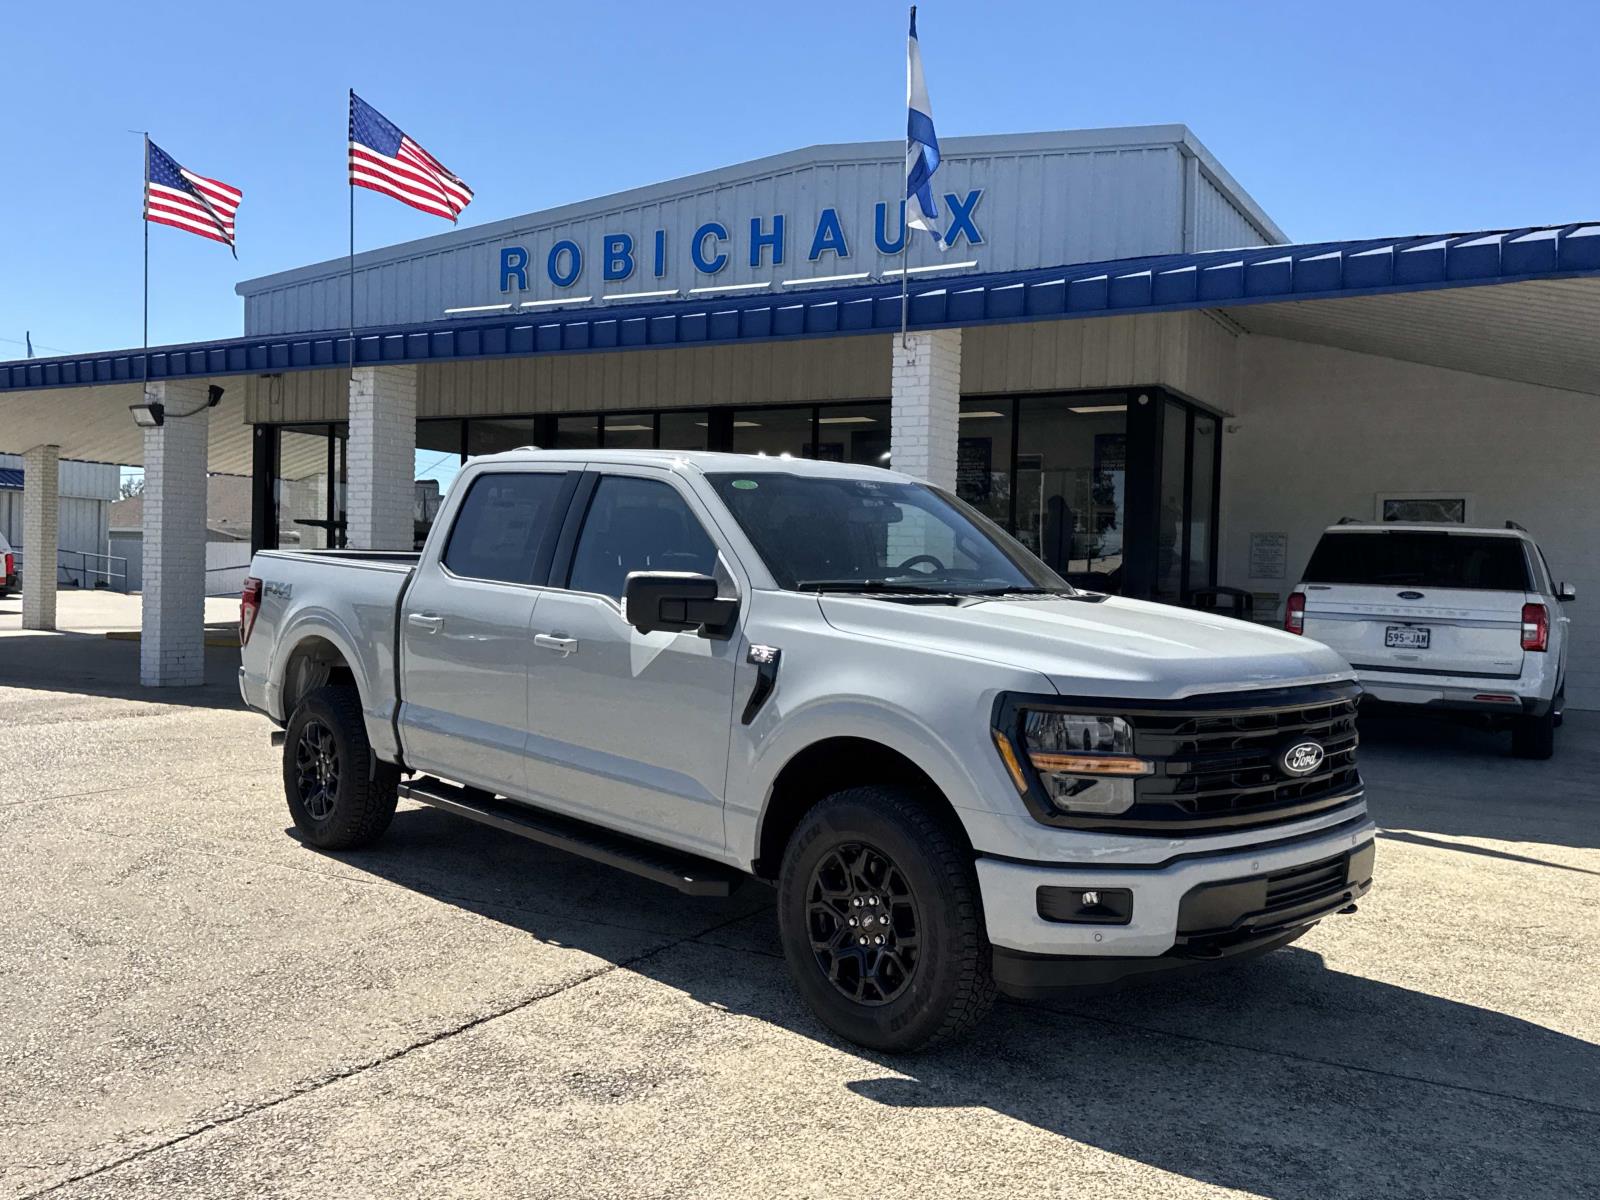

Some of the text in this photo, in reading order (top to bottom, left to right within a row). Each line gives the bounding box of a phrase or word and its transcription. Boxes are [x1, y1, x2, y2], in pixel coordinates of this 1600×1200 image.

[500, 189, 985, 292] ROBICHAUX
[264, 580, 293, 598] FX4
[1292, 746, 1318, 768] Ford
